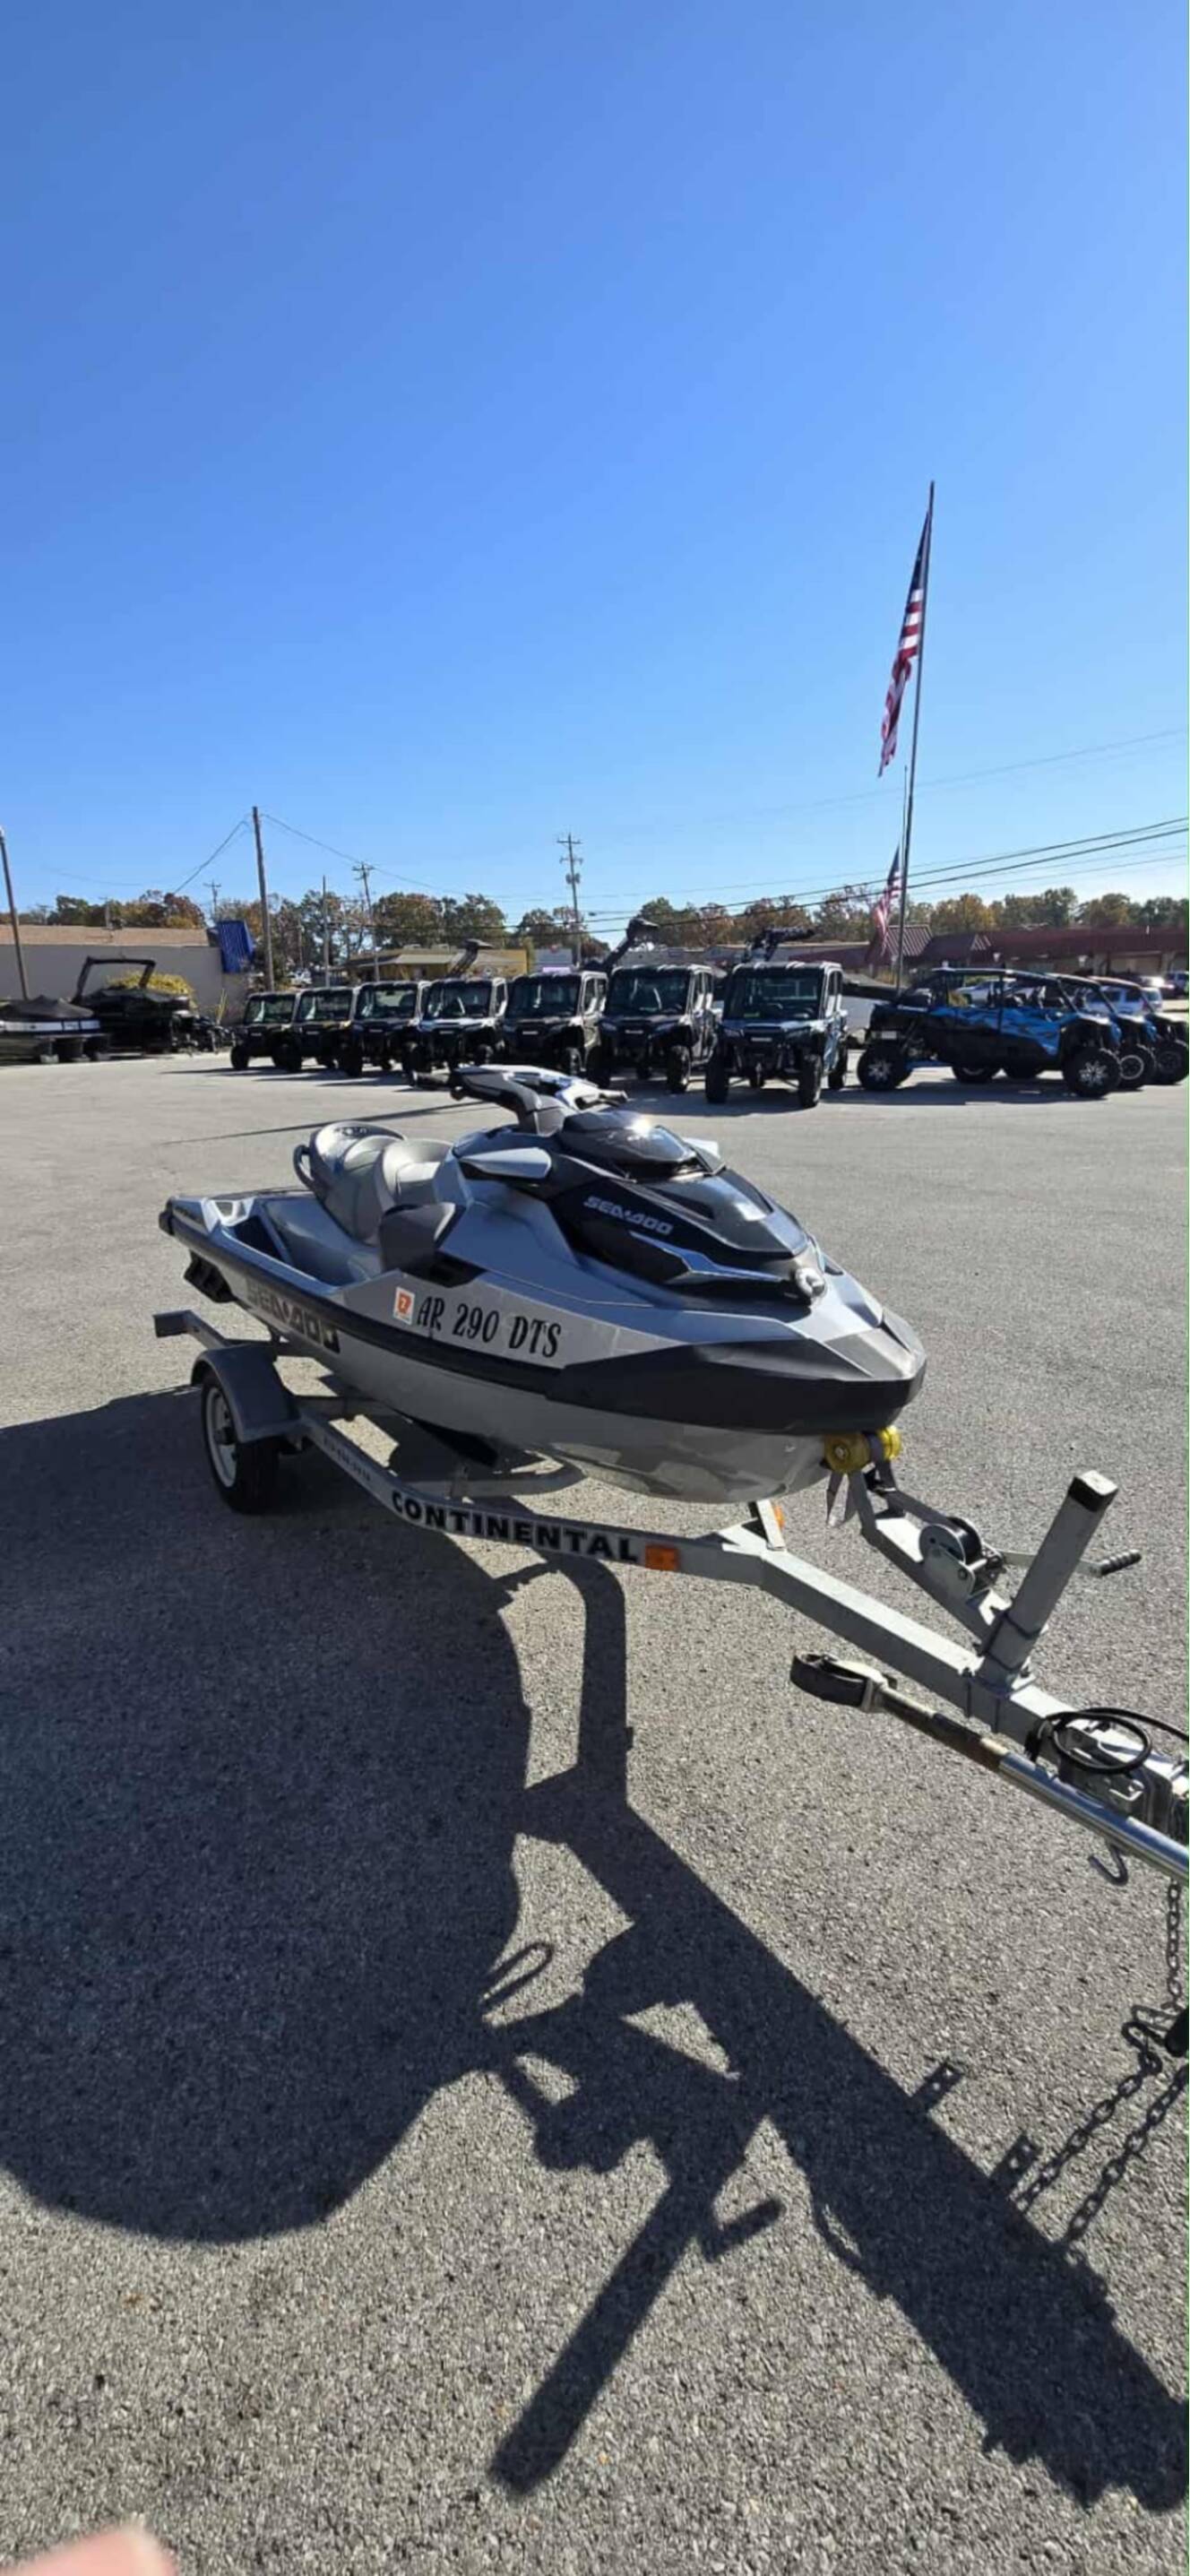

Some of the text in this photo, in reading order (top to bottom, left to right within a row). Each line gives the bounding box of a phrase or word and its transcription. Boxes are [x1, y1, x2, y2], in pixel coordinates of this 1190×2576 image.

[417, 1296, 562, 1358] AR 290 DTS
[391, 1491, 638, 1563] CONTINENTAL
